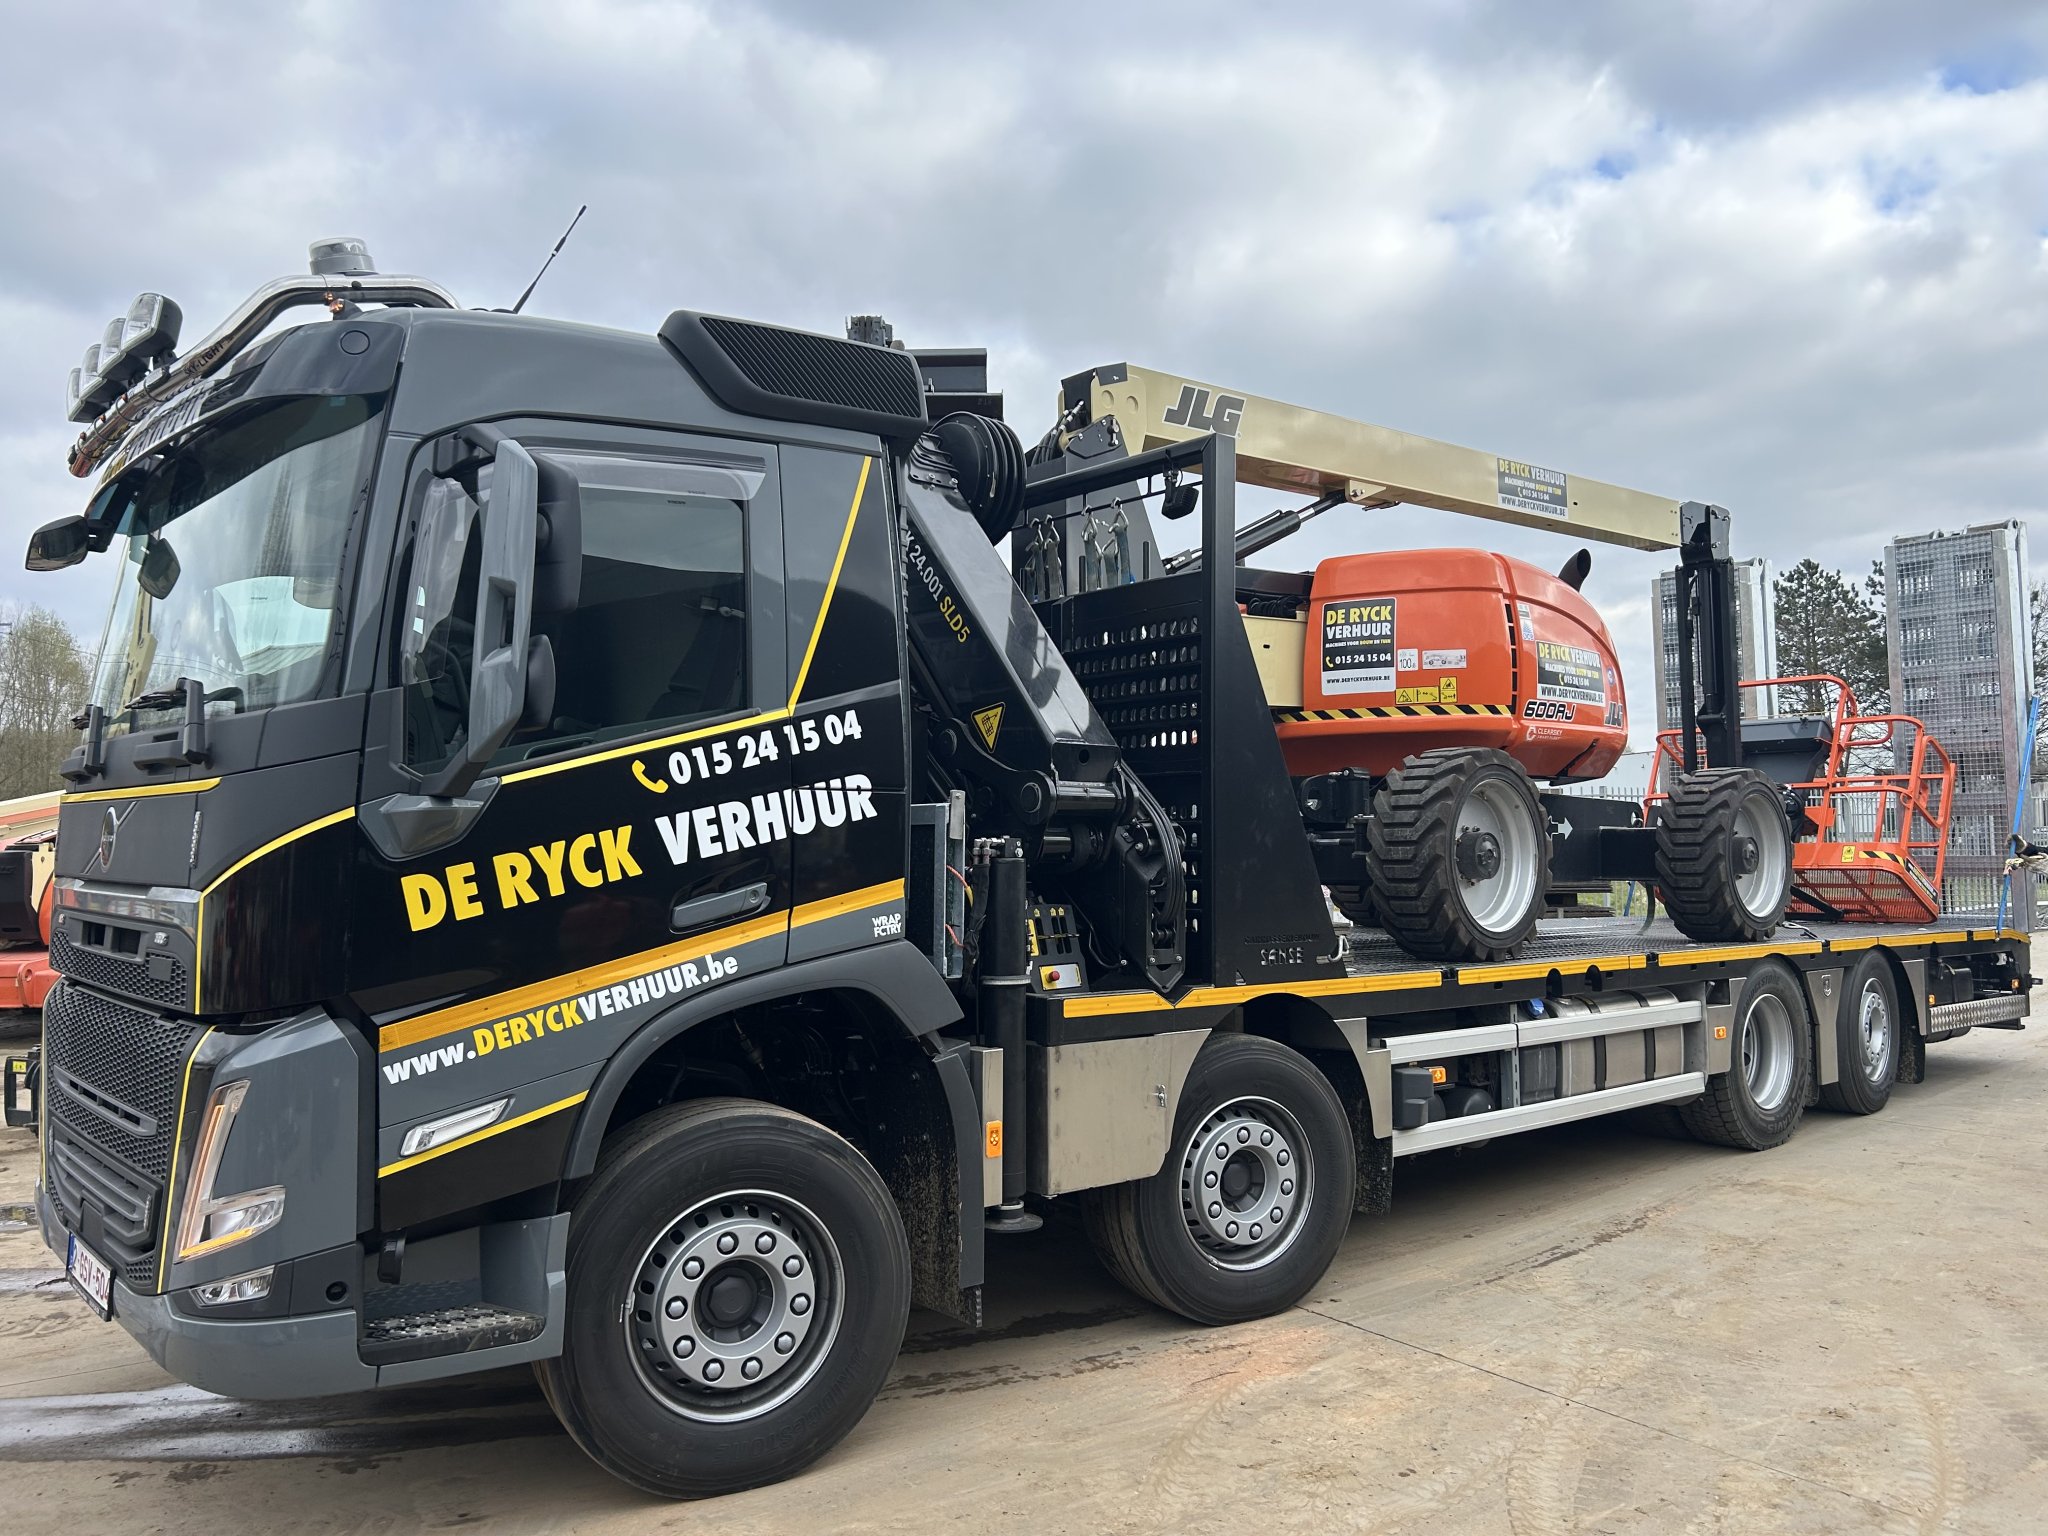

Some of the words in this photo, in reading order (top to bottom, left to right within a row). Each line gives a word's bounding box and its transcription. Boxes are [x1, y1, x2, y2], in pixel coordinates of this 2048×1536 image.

[1162, 383, 1247, 438] JLG
[1500, 459, 1509, 474] DE
[1511, 462, 1530, 478] RYCK
[1531, 466, 1565, 486] VERHUUR
[909, 545, 943, 601] 24.001
[1326, 609, 1346, 625] DE
[1350, 606, 1392, 623] RYCK
[1326, 623, 1391, 639] VERHUUR
[1335, 656, 1352, 664] 015
[1353, 655, 1364, 663] 24
[1367, 654, 1378, 662] 15
[1380, 653, 1391, 661] 04
[1400, 658, 1412, 668] 100
[1539, 643, 1549, 658] DE
[1551, 644, 1570, 662] RYCK
[1571, 649, 1601, 668] VERHUUR
[1326, 675, 1390, 684] WWW.DERYCKVERHUUR.BE
[1524, 700, 1575, 721] 600AJ
[1605, 702, 1623, 727] JLG
[1538, 728, 1562, 736] CLEARSKY
[668, 741, 732, 785] 015
[737, 730, 779, 768] 24
[783, 719, 820, 755] 15
[824, 709, 862, 745] 04
[401, 862, 484, 932] DE
[492, 825, 643, 909] RYCK
[654, 773, 878, 866] VERHUUR
[872, 913, 901, 926] WRAP
[874, 922, 901, 937] FCTRY
[1260, 946, 1304, 966] SANSE
[382, 953, 739, 1085] www.DERYCKVERHUUR.be
